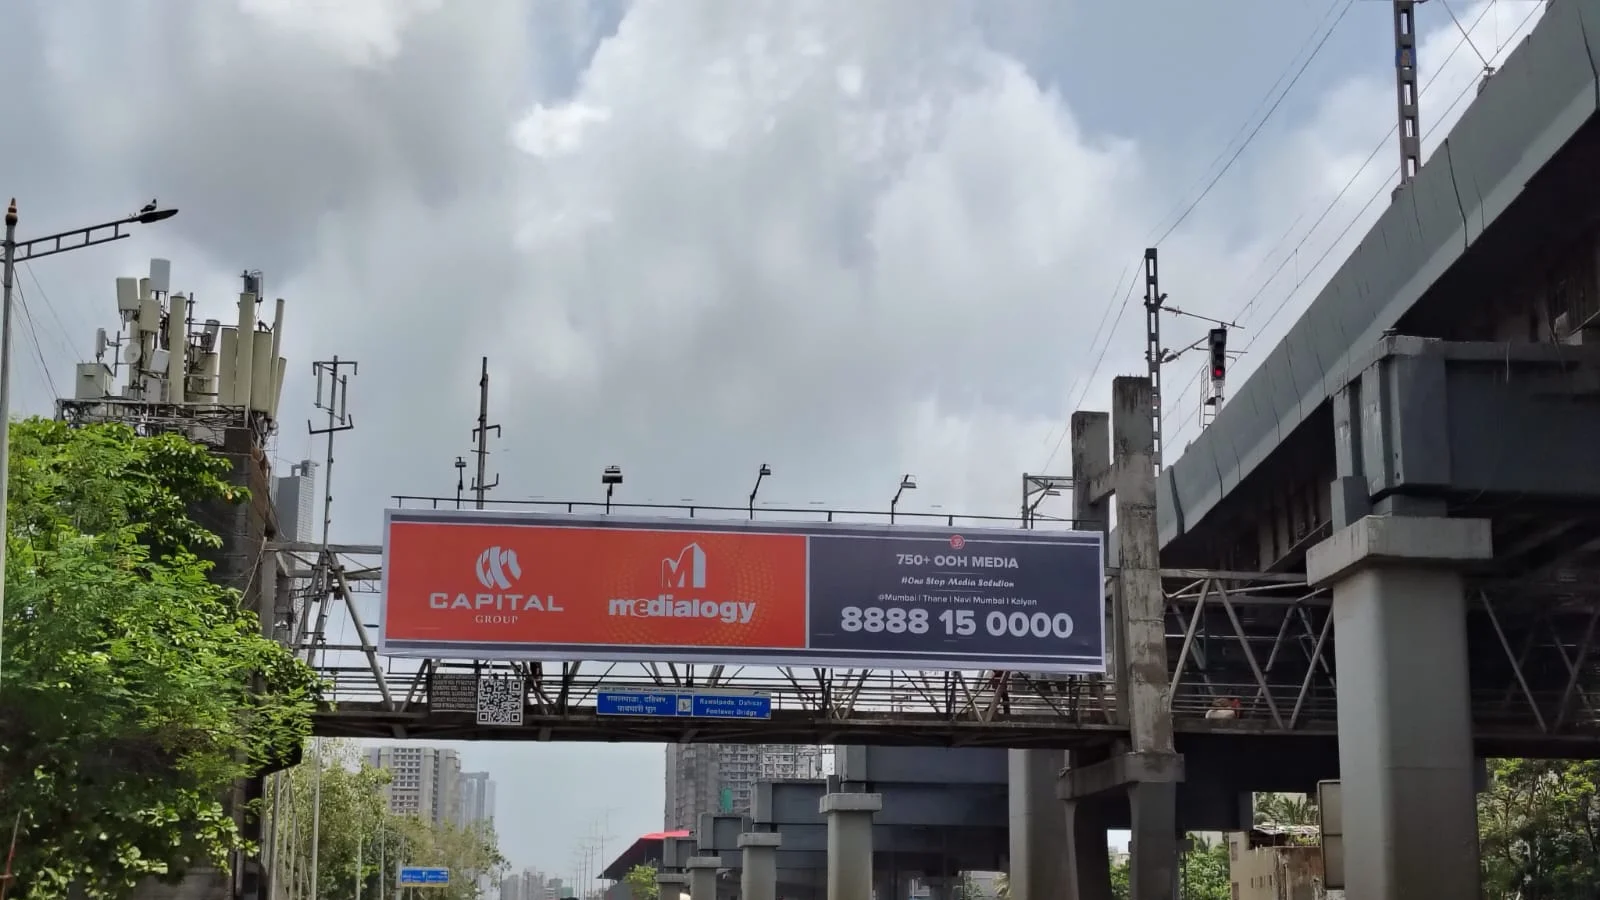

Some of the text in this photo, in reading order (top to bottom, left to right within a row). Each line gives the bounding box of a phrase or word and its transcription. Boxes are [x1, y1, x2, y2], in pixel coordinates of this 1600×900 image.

[895, 553, 1020, 569] 750+ OOH MEDIA
[901, 576, 1015, 588] #One Stop Media Solution
[429, 592, 565, 612] CAPITAL
[878, 593, 917, 602] @Mumbai
[923, 594, 948, 603] Thane
[953, 595, 972, 604] Navi
[973, 596, 1005, 605] Mumbai
[1011, 597, 1038, 606] Kalyan
[608, 593, 757, 624] medialogy
[475, 614, 519, 624] GROUP
[840, 606, 1074, 639] 8888 15 0000
